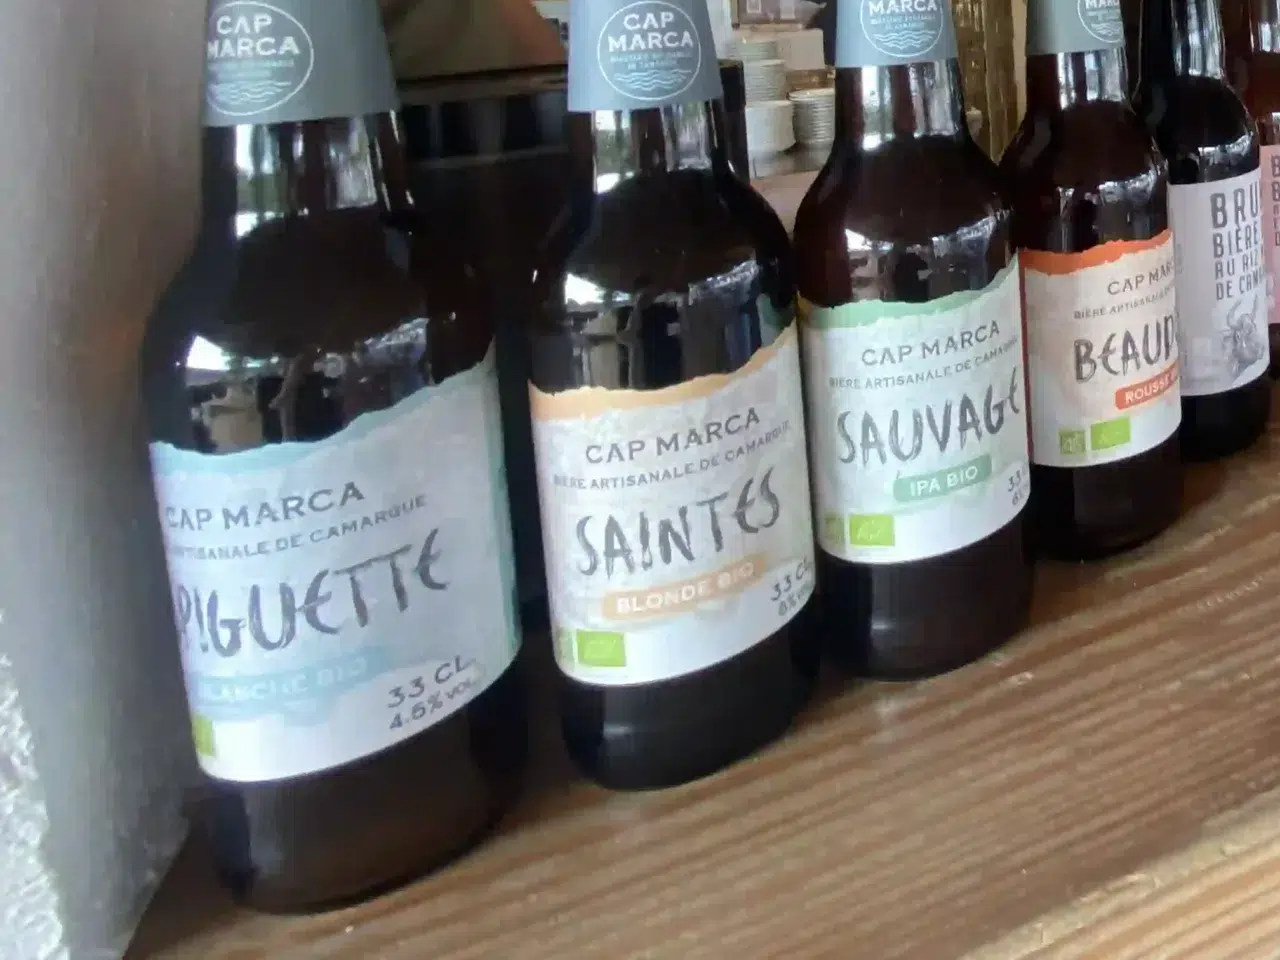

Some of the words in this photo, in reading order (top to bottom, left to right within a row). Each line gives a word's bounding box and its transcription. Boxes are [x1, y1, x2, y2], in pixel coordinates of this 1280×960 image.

[217, 13, 273, 35] CAP
[623, 11, 674, 31] CAP
[607, 30, 694, 53] MARCA
[1210, 180, 1260, 230] BRU
[1107, 274, 1145, 296] CAP
[1148, 261, 1174, 284] MAR
[1216, 281, 1233, 301] DE
[861, 345, 913, 367] CAP
[922, 320, 1000, 359] MARCA
[864, 366, 953, 390] ARTISANALE
[955, 359, 972, 373] DE
[837, 365, 1020, 467] SAUVAGE
[585, 440, 645, 464] CAP
[656, 407, 760, 456] MARCA
[590, 462, 695, 490] ARTISANALE
[700, 453, 719, 471] DE
[909, 480, 940, 497] IPA
[946, 465, 978, 488] BIO
[165, 506, 213, 531] CAP
[222, 481, 365, 531] MARCA
[575, 465, 780, 580] SAINTES
[276, 534, 304, 552] DE
[615, 579, 711, 614] BLONDE
[717, 561, 756, 590] BIO
[387, 675, 425, 709] 33
[434, 654, 477, 685] CL
